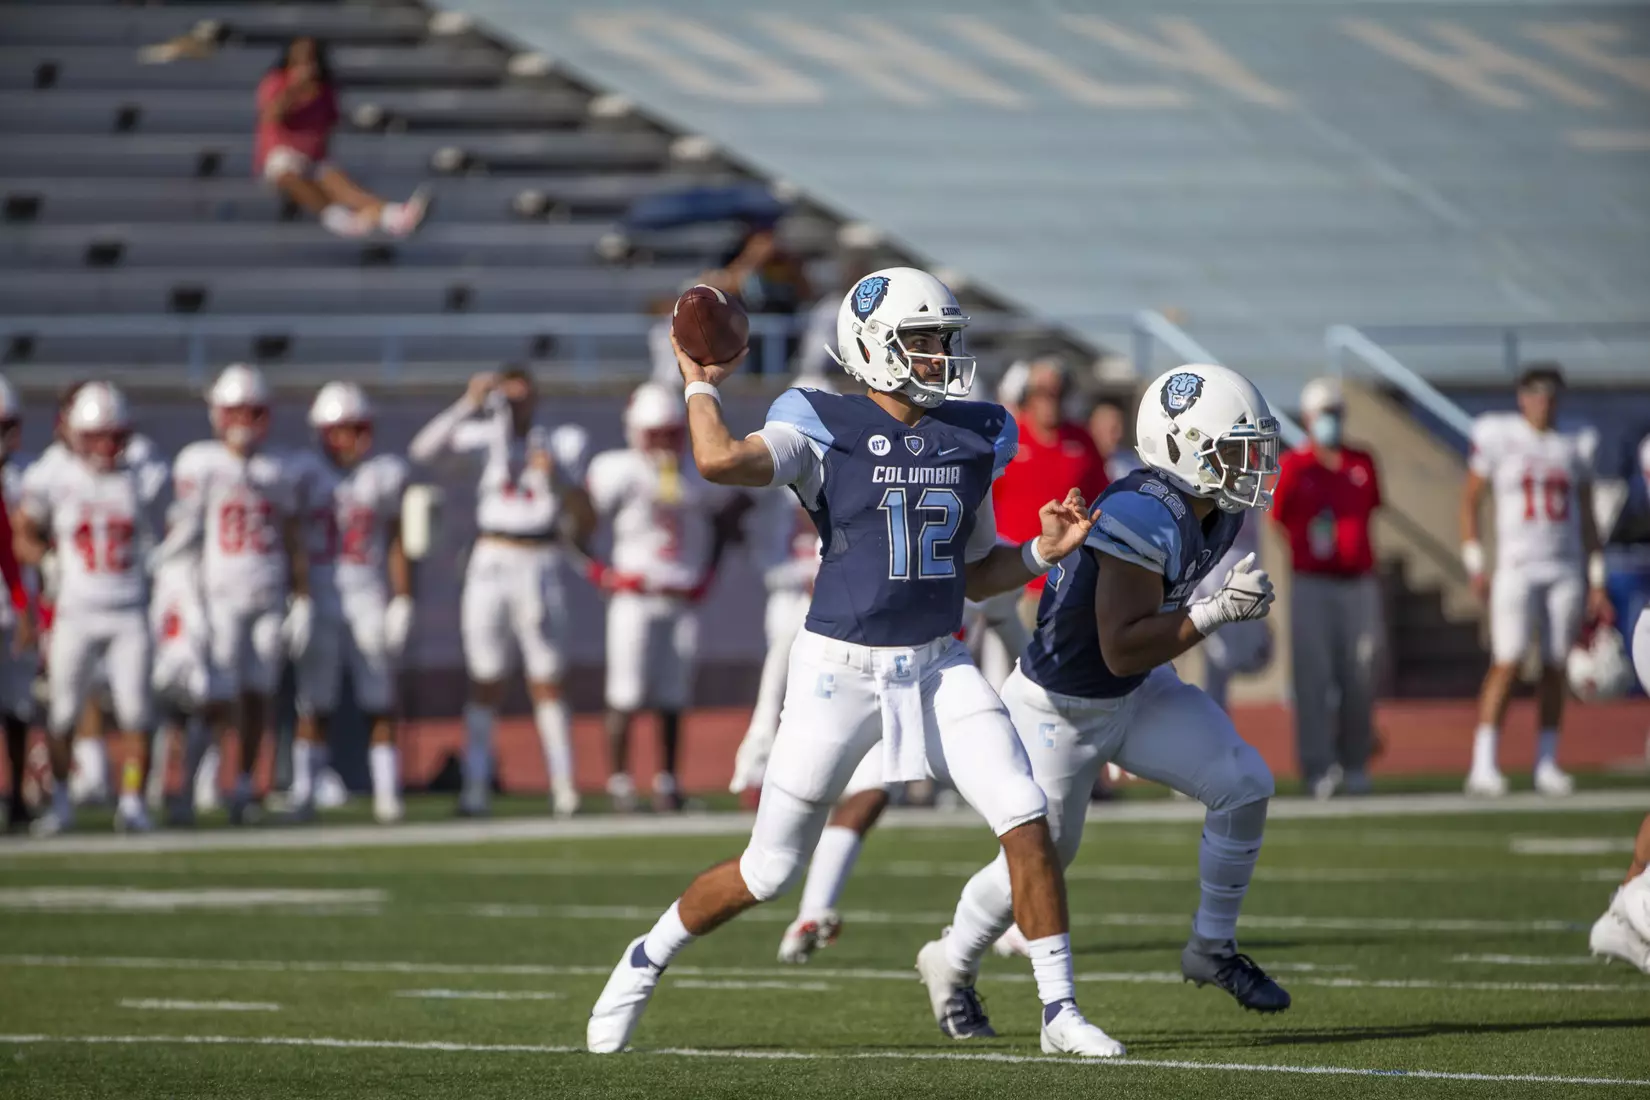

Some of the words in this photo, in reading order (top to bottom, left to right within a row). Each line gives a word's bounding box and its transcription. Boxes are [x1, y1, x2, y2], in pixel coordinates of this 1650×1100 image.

[872, 465, 961, 484] COLUMBIA
[1139, 479, 1186, 520] 22
[876, 487, 964, 580] 12
